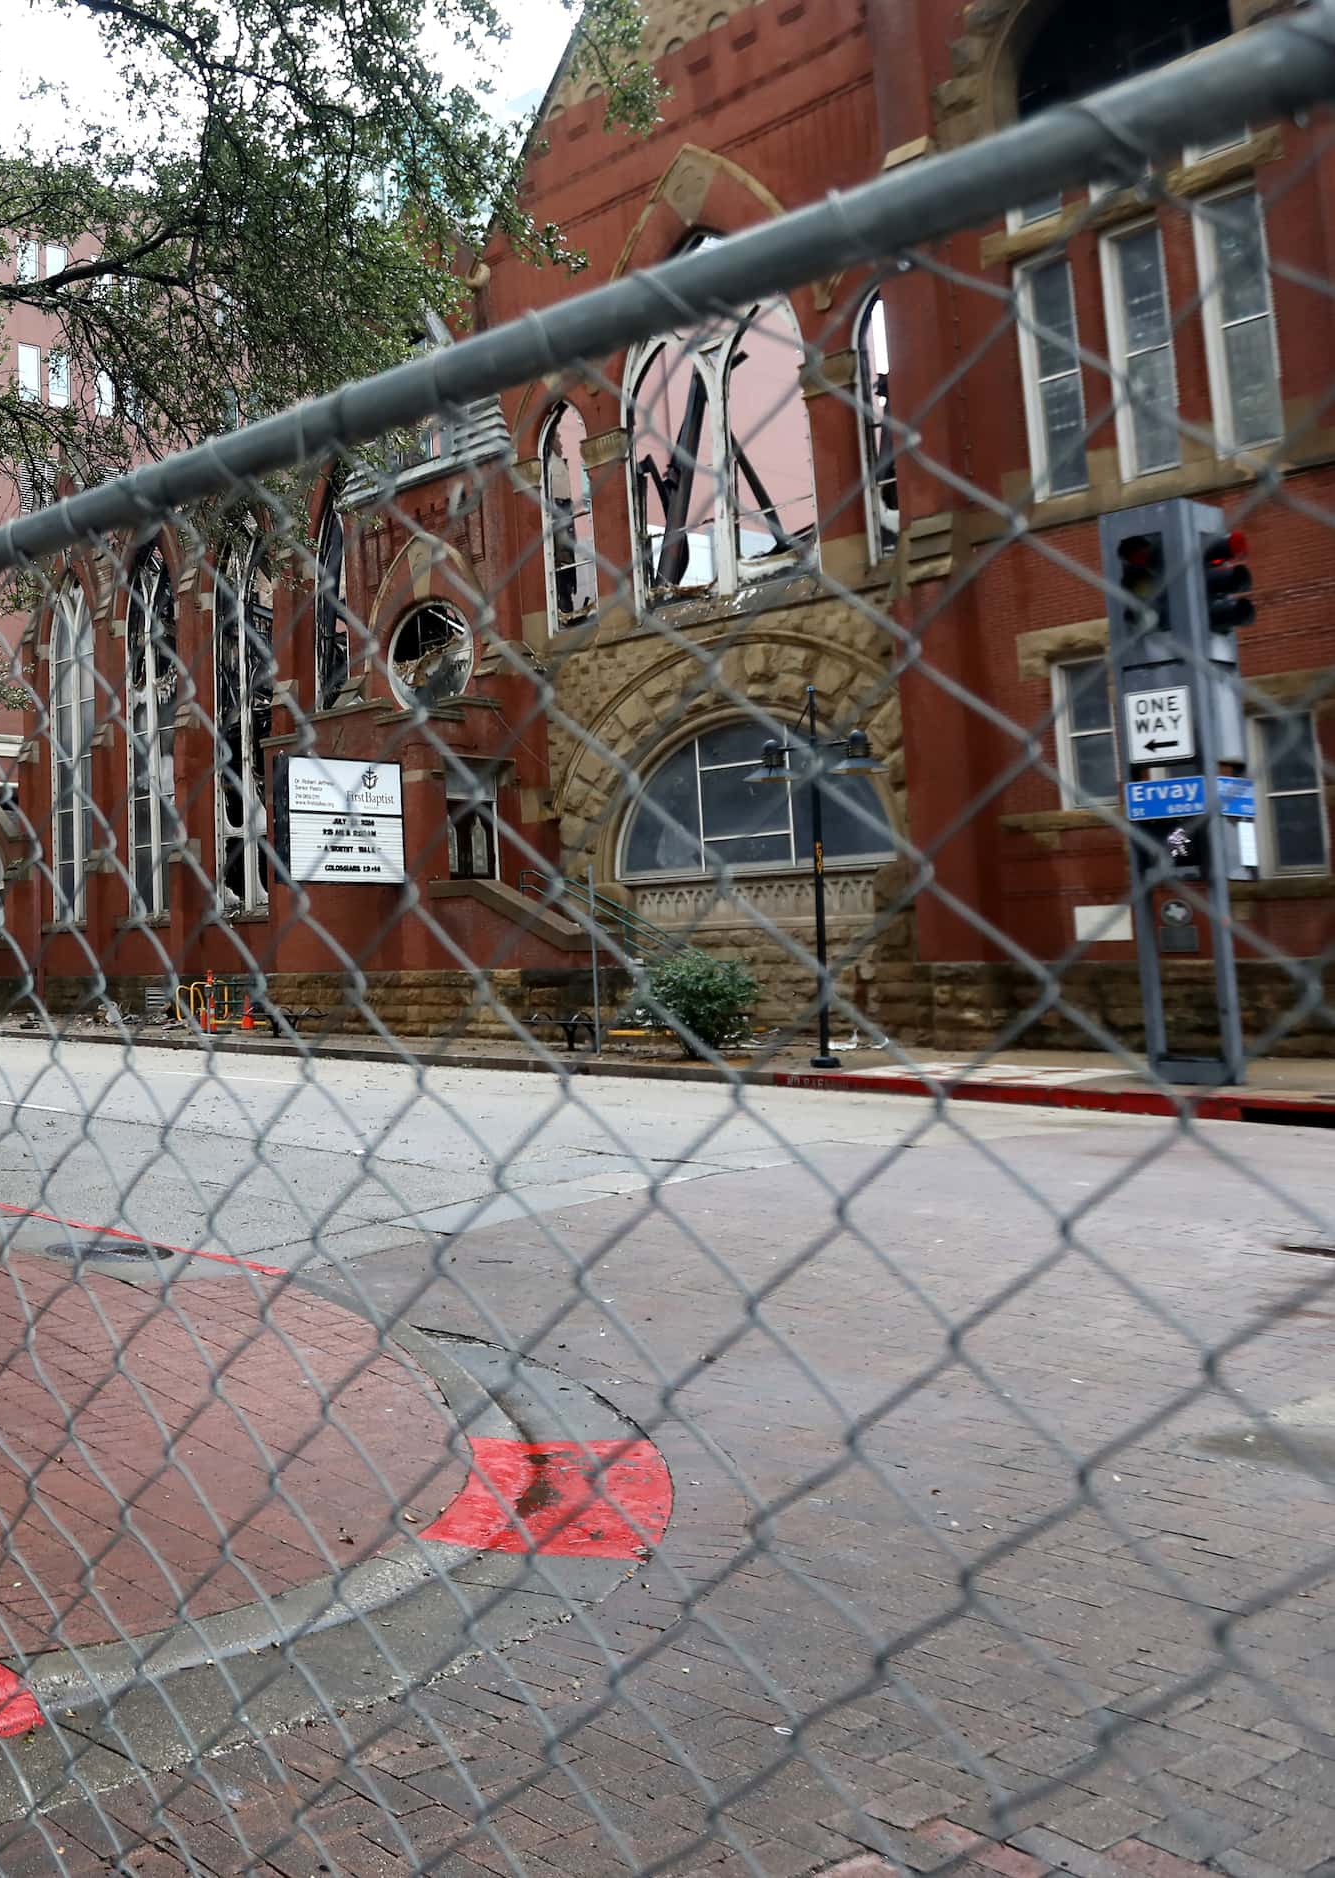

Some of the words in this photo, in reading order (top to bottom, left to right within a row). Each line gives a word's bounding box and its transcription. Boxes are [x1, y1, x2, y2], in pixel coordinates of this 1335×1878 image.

[1136, 695, 1179, 715] ONE
[1135, 714, 1181, 734] WAY
[365, 792, 394, 806] Baptist
[1131, 783, 1198, 802] Ervay
